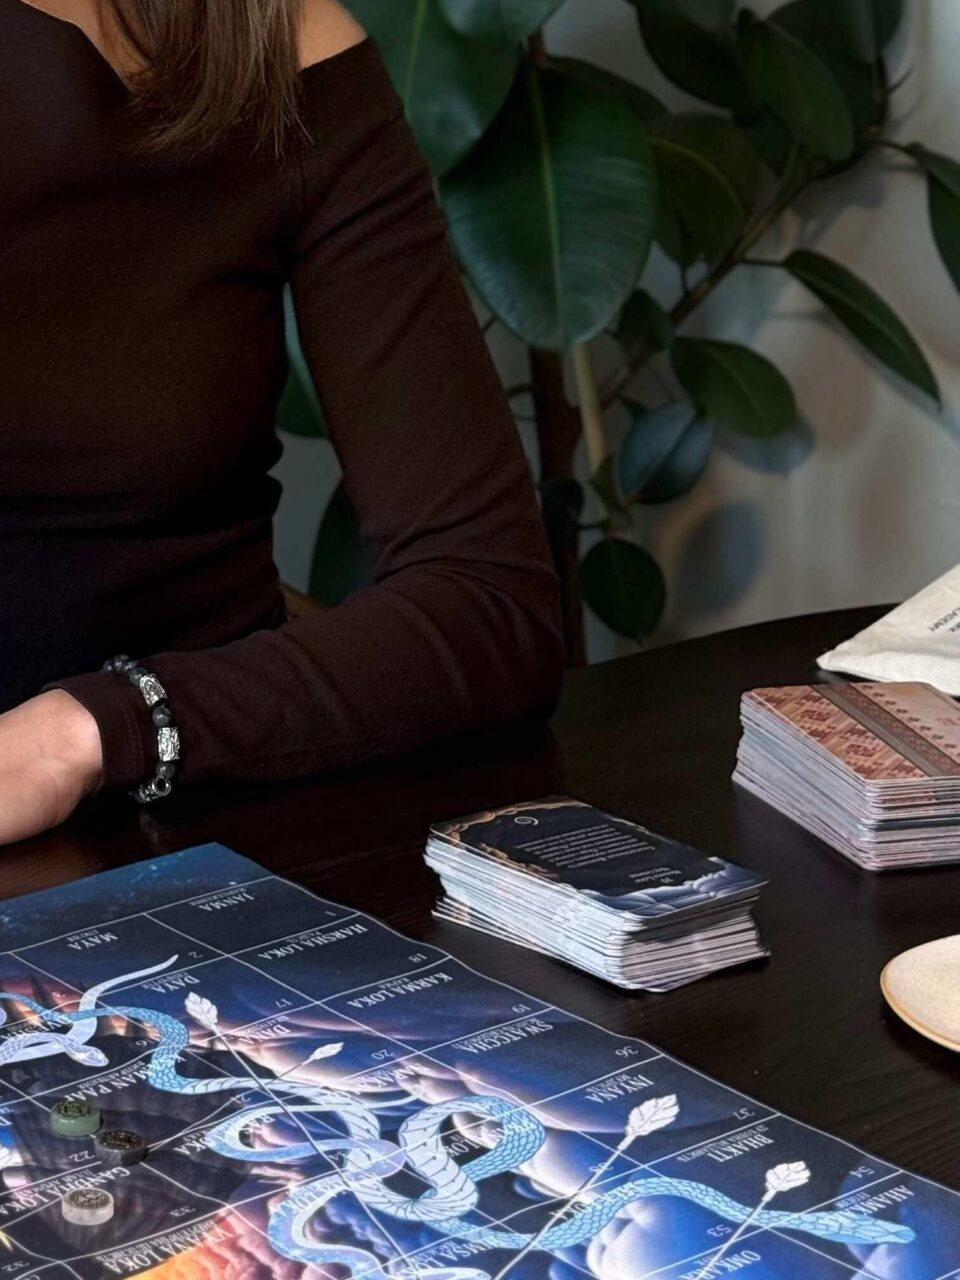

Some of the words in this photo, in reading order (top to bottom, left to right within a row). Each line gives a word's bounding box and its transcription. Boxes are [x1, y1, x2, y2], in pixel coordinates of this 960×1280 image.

[198, 892, 255, 911] JANMA
[67, 931, 119, 951] MAYA
[300, 923, 368, 947] HARSHA
[257, 943, 304, 960] LOKA
[407, 951, 428, 964] 18
[150, 974, 200, 994] DAYA
[389, 971, 453, 996] KARMA
[275, 998, 293, 1008] 17
[346, 987, 394, 1009] LOKA
[511, 1003, 532, 1014] 19
[458, 1020, 554, 1054] SWATCCHA
[370, 1049, 393, 1060] 20
[614, 1045, 638, 1058] 36
[732, 1107, 755, 1120] 37
[68, 1150, 95, 1162] 22
[707, 1133, 774, 1163] BHAKTI
[848, 1165, 875, 1178] 54
[45, 1165, 131, 1197] GANDHA
[169, 1205, 196, 1218] 33
[706, 1224, 732, 1238] 53
[160, 1224, 234, 1256] VYANA
[0, 1260, 30, 1272] 32
[101, 1249, 163, 1275] LOKA
